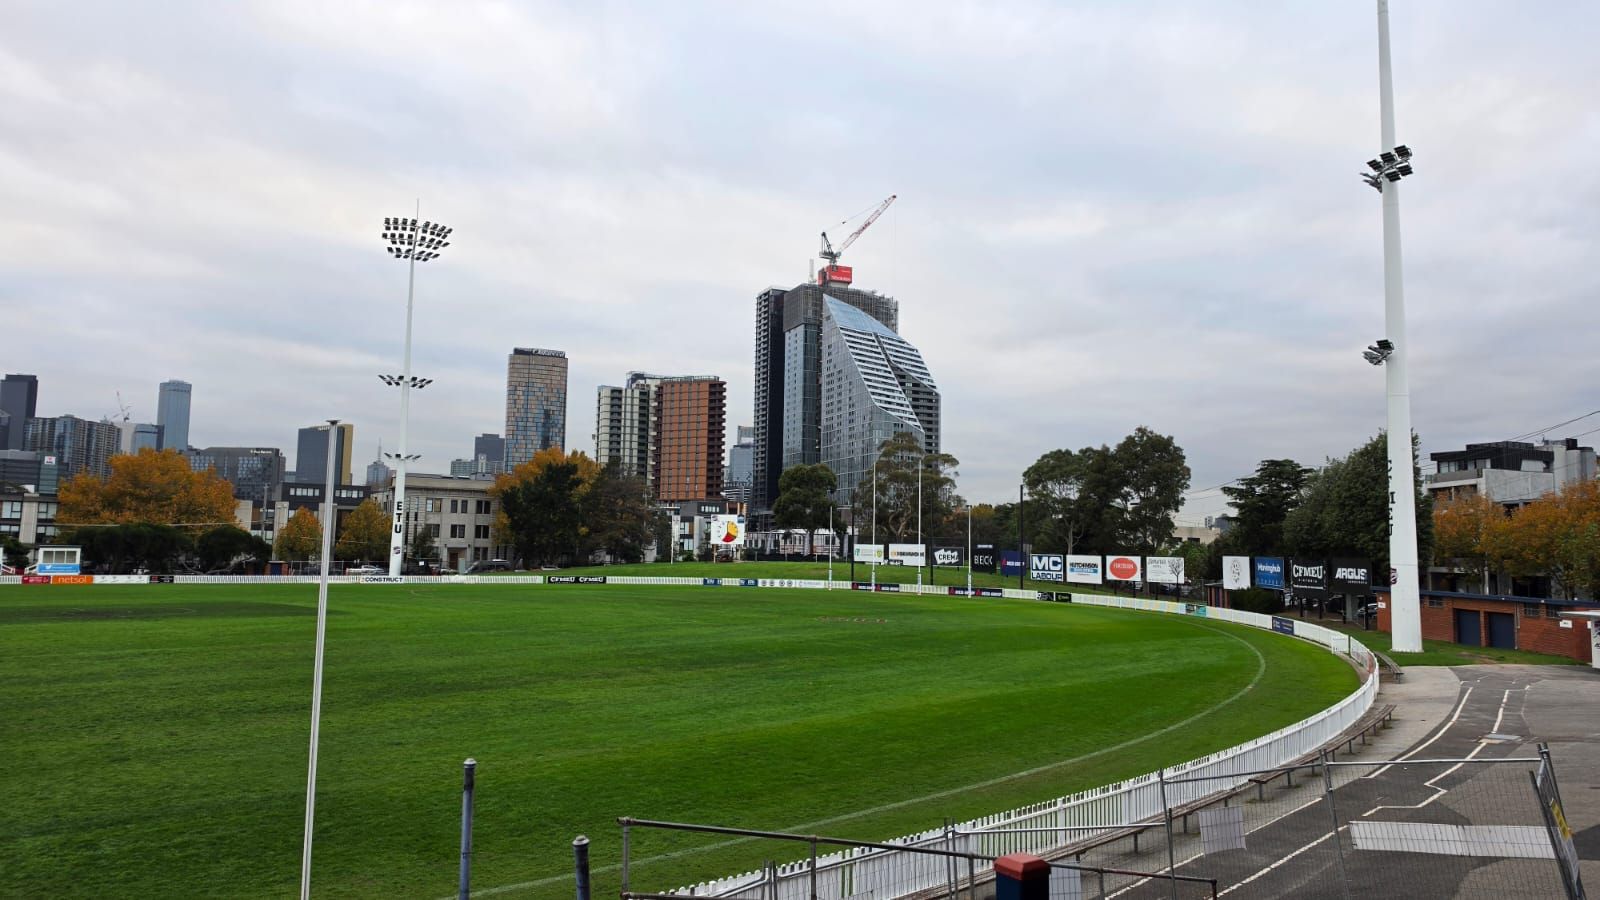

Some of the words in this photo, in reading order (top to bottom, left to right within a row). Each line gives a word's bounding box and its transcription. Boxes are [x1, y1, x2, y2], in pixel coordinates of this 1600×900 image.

[1032, 555, 1062, 571] MC
[1032, 571, 1063, 580] LABOUR
[1293, 564, 1323, 579] CFMEU
[1335, 567, 1367, 581] ARGUS
[57, 576, 87, 584] netsol
